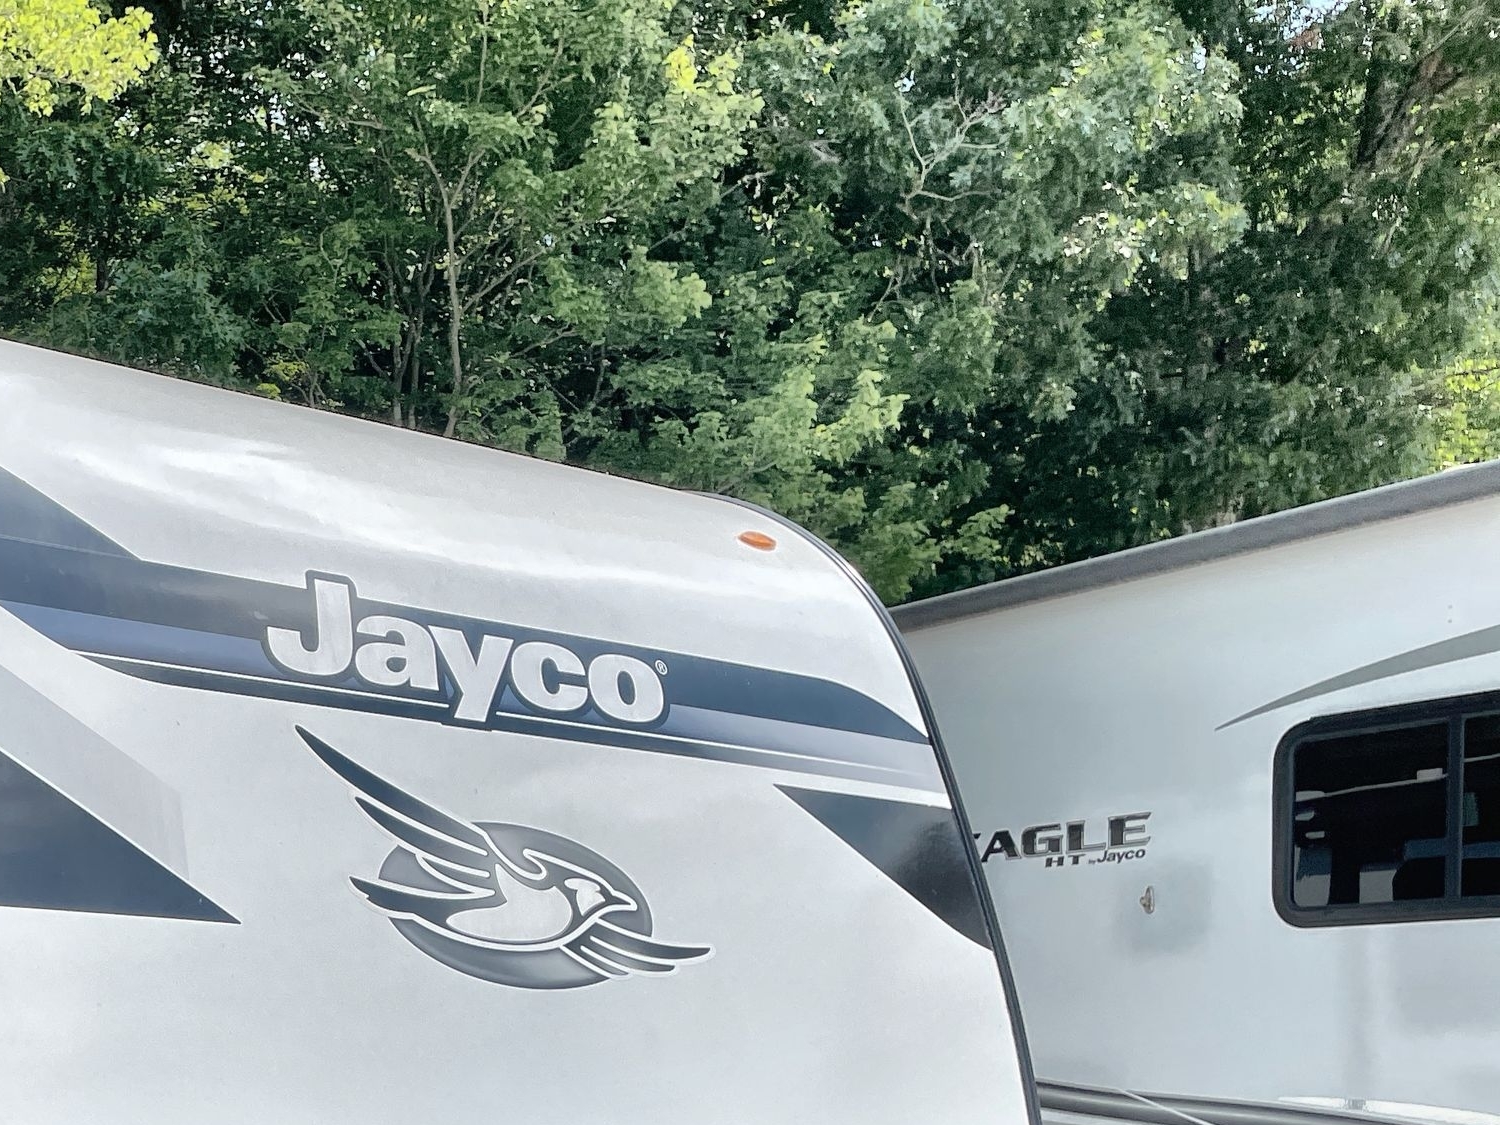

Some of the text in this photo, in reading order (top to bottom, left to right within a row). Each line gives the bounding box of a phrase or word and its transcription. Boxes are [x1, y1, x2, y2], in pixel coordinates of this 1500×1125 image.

[974, 812, 1152, 863] AGLE
[1045, 853, 1085, 868] HT
[1097, 848, 1147, 864] Jayco
